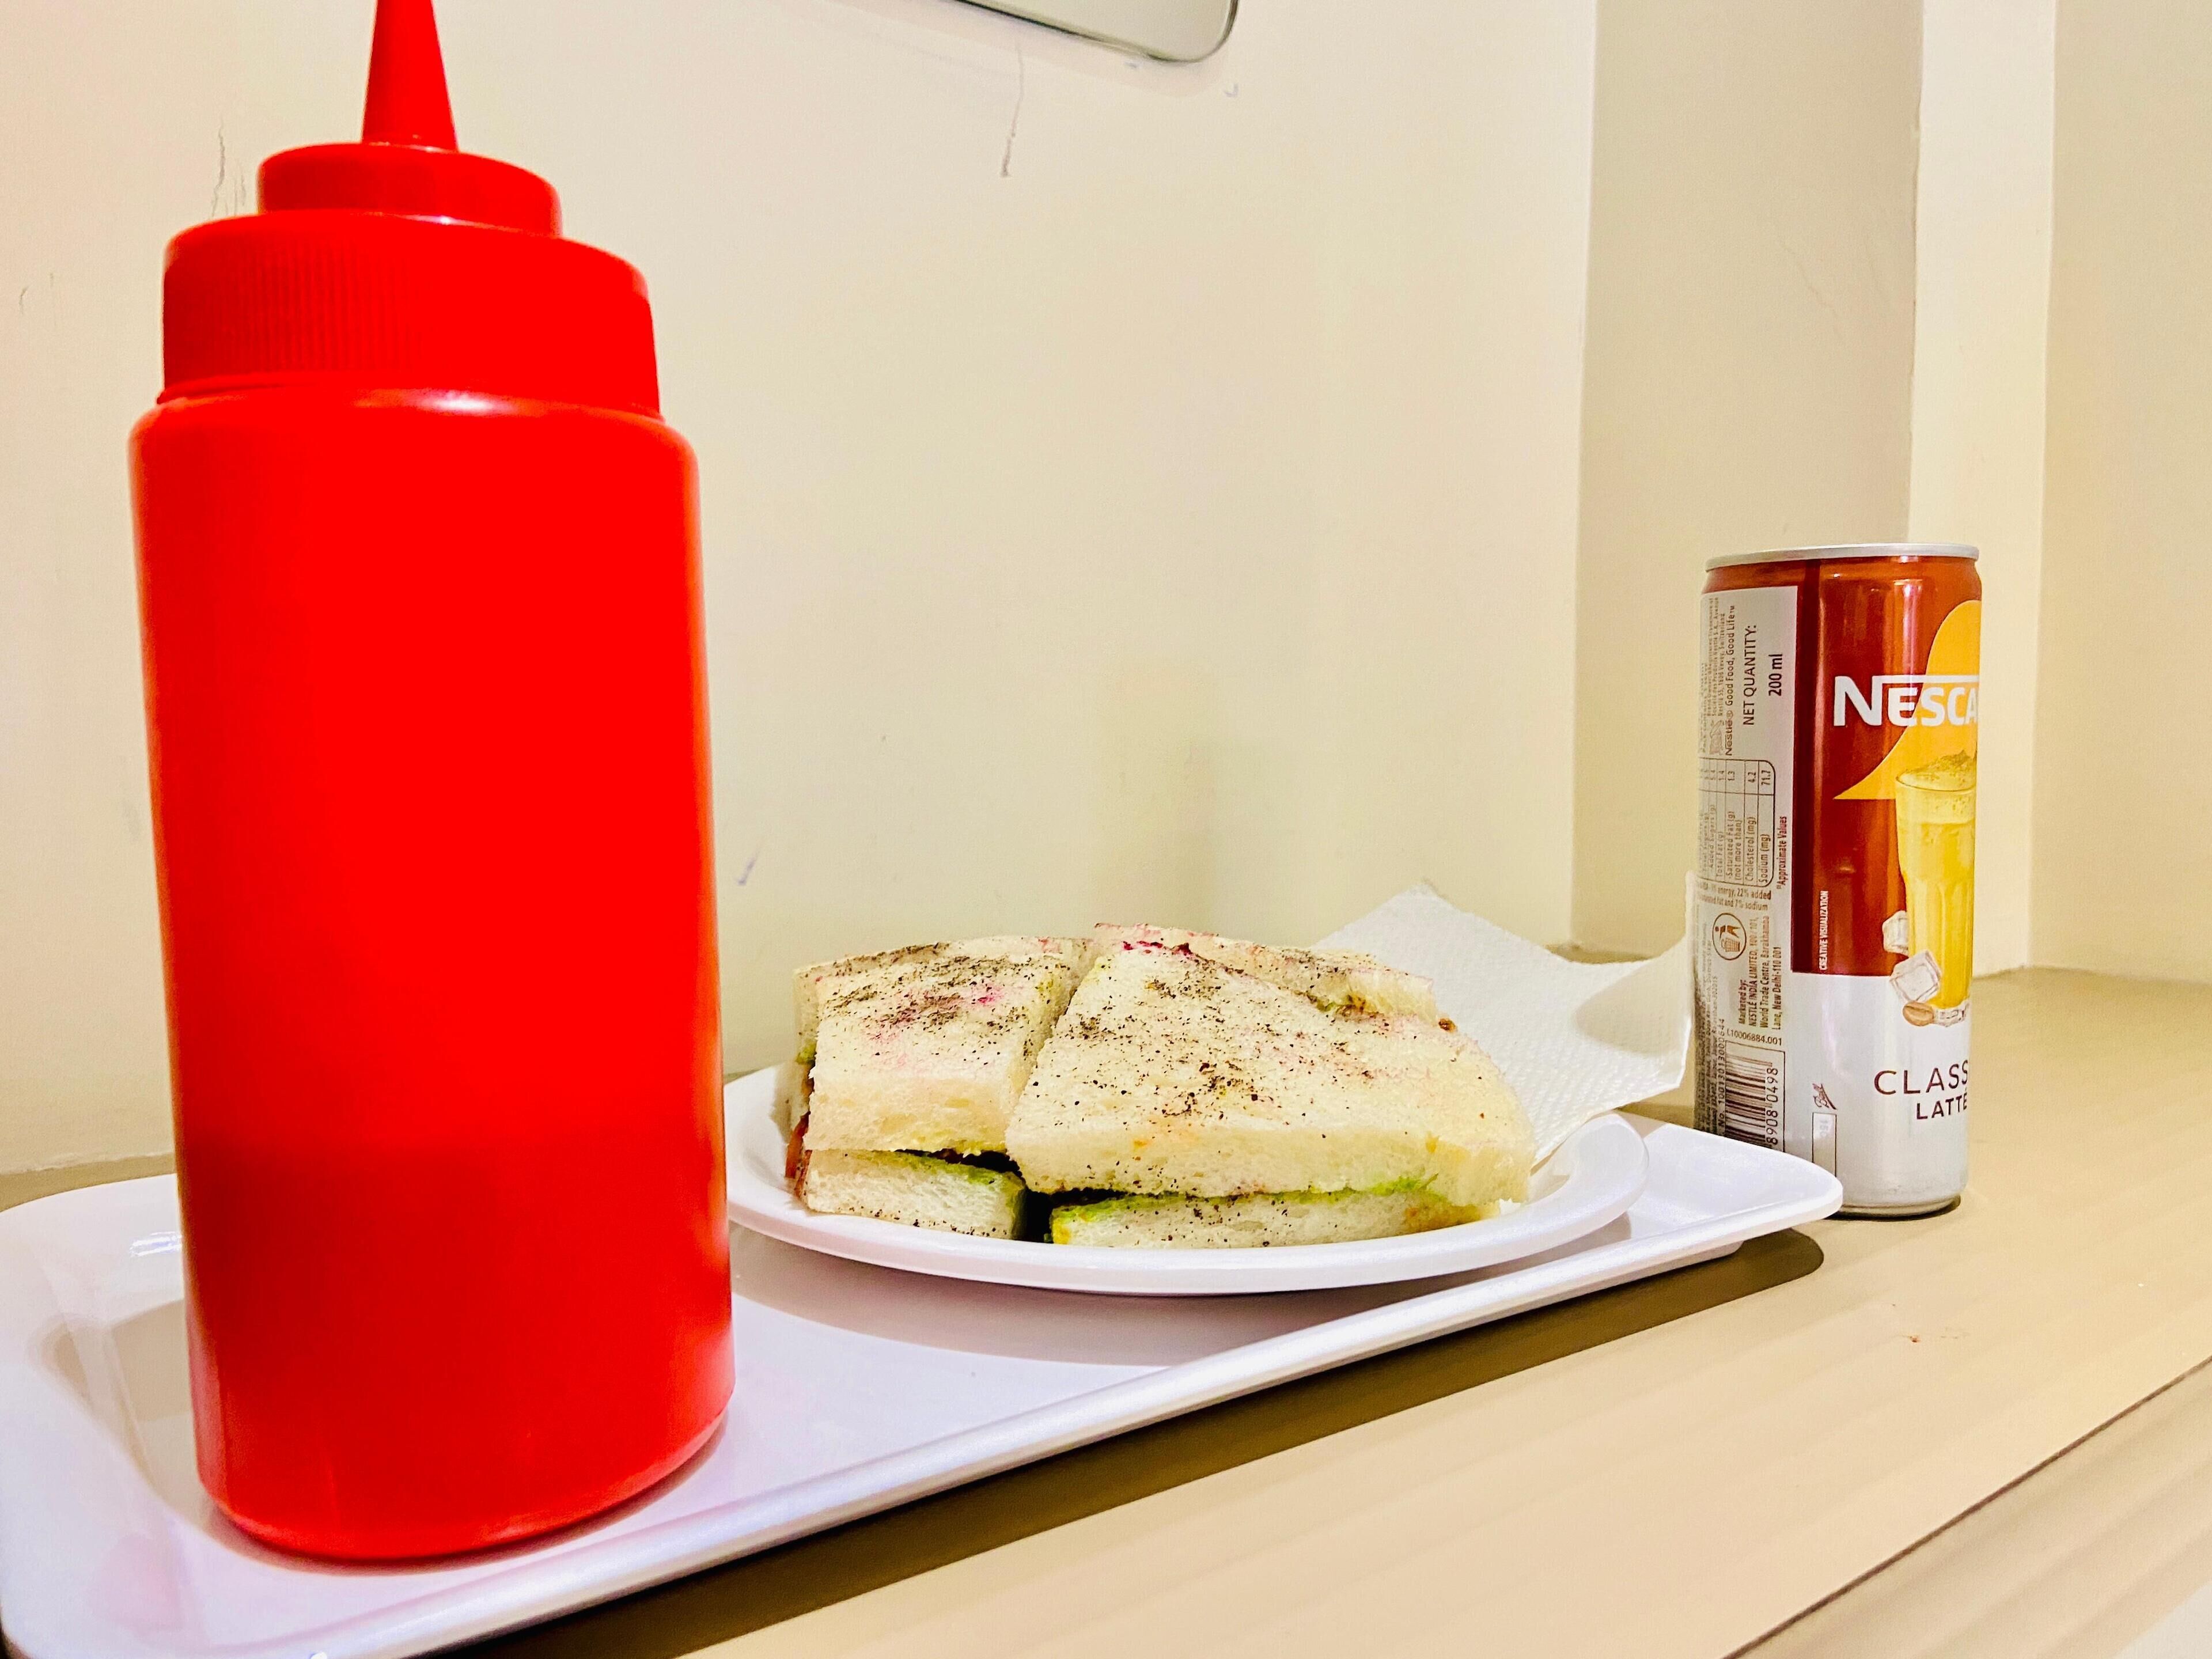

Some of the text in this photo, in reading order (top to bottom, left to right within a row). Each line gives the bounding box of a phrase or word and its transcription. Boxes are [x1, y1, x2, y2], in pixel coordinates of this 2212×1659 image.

[1725, 658, 1734, 680] Food,
[1743, 625, 1756, 725] NET QUANTITY:
[1768, 654, 1782, 696] 200 ml
[1726, 811, 1735, 821] (g)
[1745, 772, 1756, 881] Cholesterol (mg) 4.2
[1758, 770, 1771, 882] Sodium (mg) 71.7
[1734, 820, 1743, 840] than)
[1777, 816, 1787, 839] Values
[1734, 865, 1742, 880] (not
[1745, 901, 1768, 911] sodium
[1751, 890, 1771, 900] added
[1819, 891, 1828, 970] CREATIVE VISUALIZATION
[1772, 947, 1781, 959] 001
[1760, 916, 1770, 1028] World Trade Centre, Barakhamba
[1738, 979, 1748, 990] by:
[1749, 980, 1757, 1000] INDIA
[1772, 994, 1781, 1010] New
[1747, 1001, 1757, 1027] NESTLÉ
[1772, 1012, 1782, 1030] Lane,
[1874, 1060, 1968, 1095] CLASS
[1766, 1068, 1778, 1145] 8908 0498
